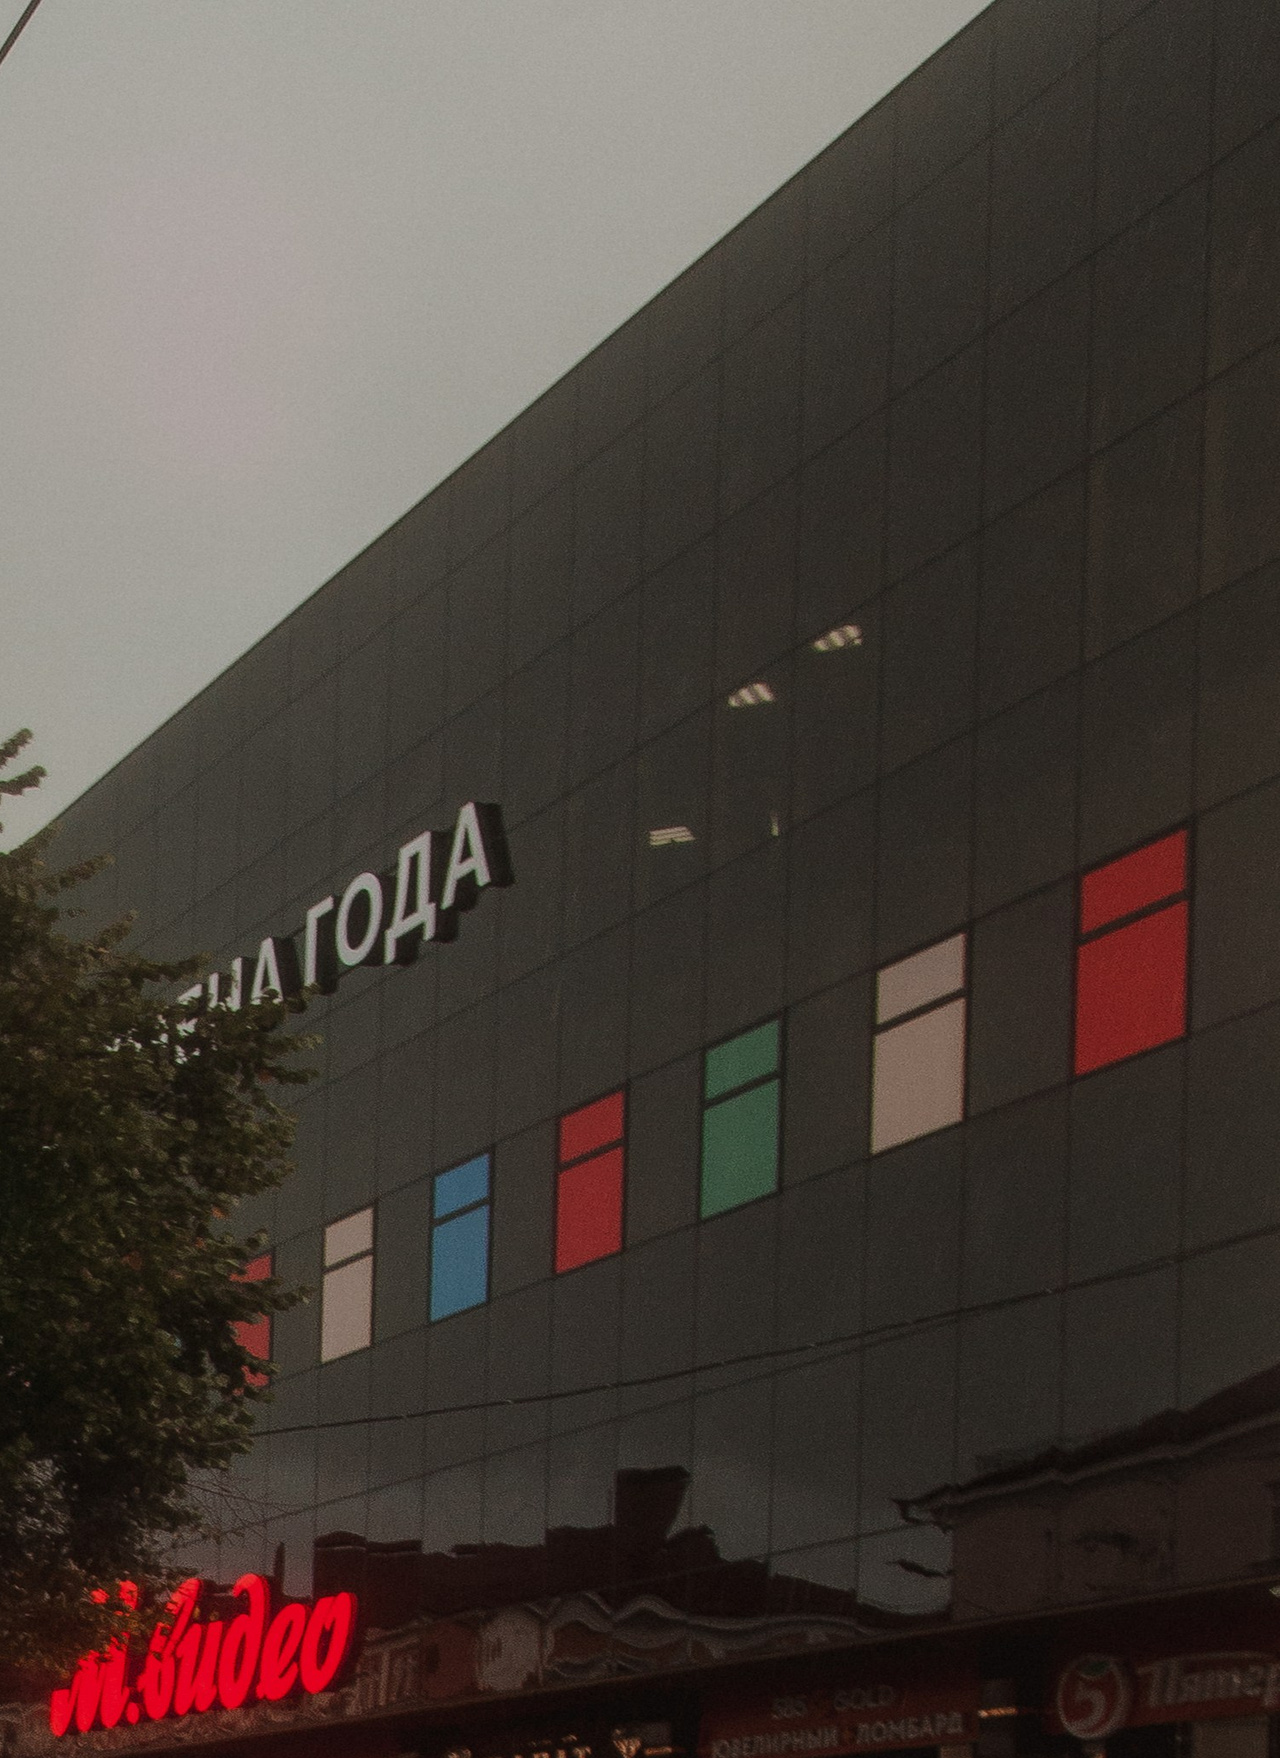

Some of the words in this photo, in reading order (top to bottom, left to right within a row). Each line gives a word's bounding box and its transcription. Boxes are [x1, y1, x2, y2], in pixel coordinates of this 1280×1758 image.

[304, 801, 491, 988] ГОДА
[771, 1695, 808, 1720] 585
[833, 1684, 897, 1711] GOLD
[856, 1712, 964, 1745] ЛОМБАРД
